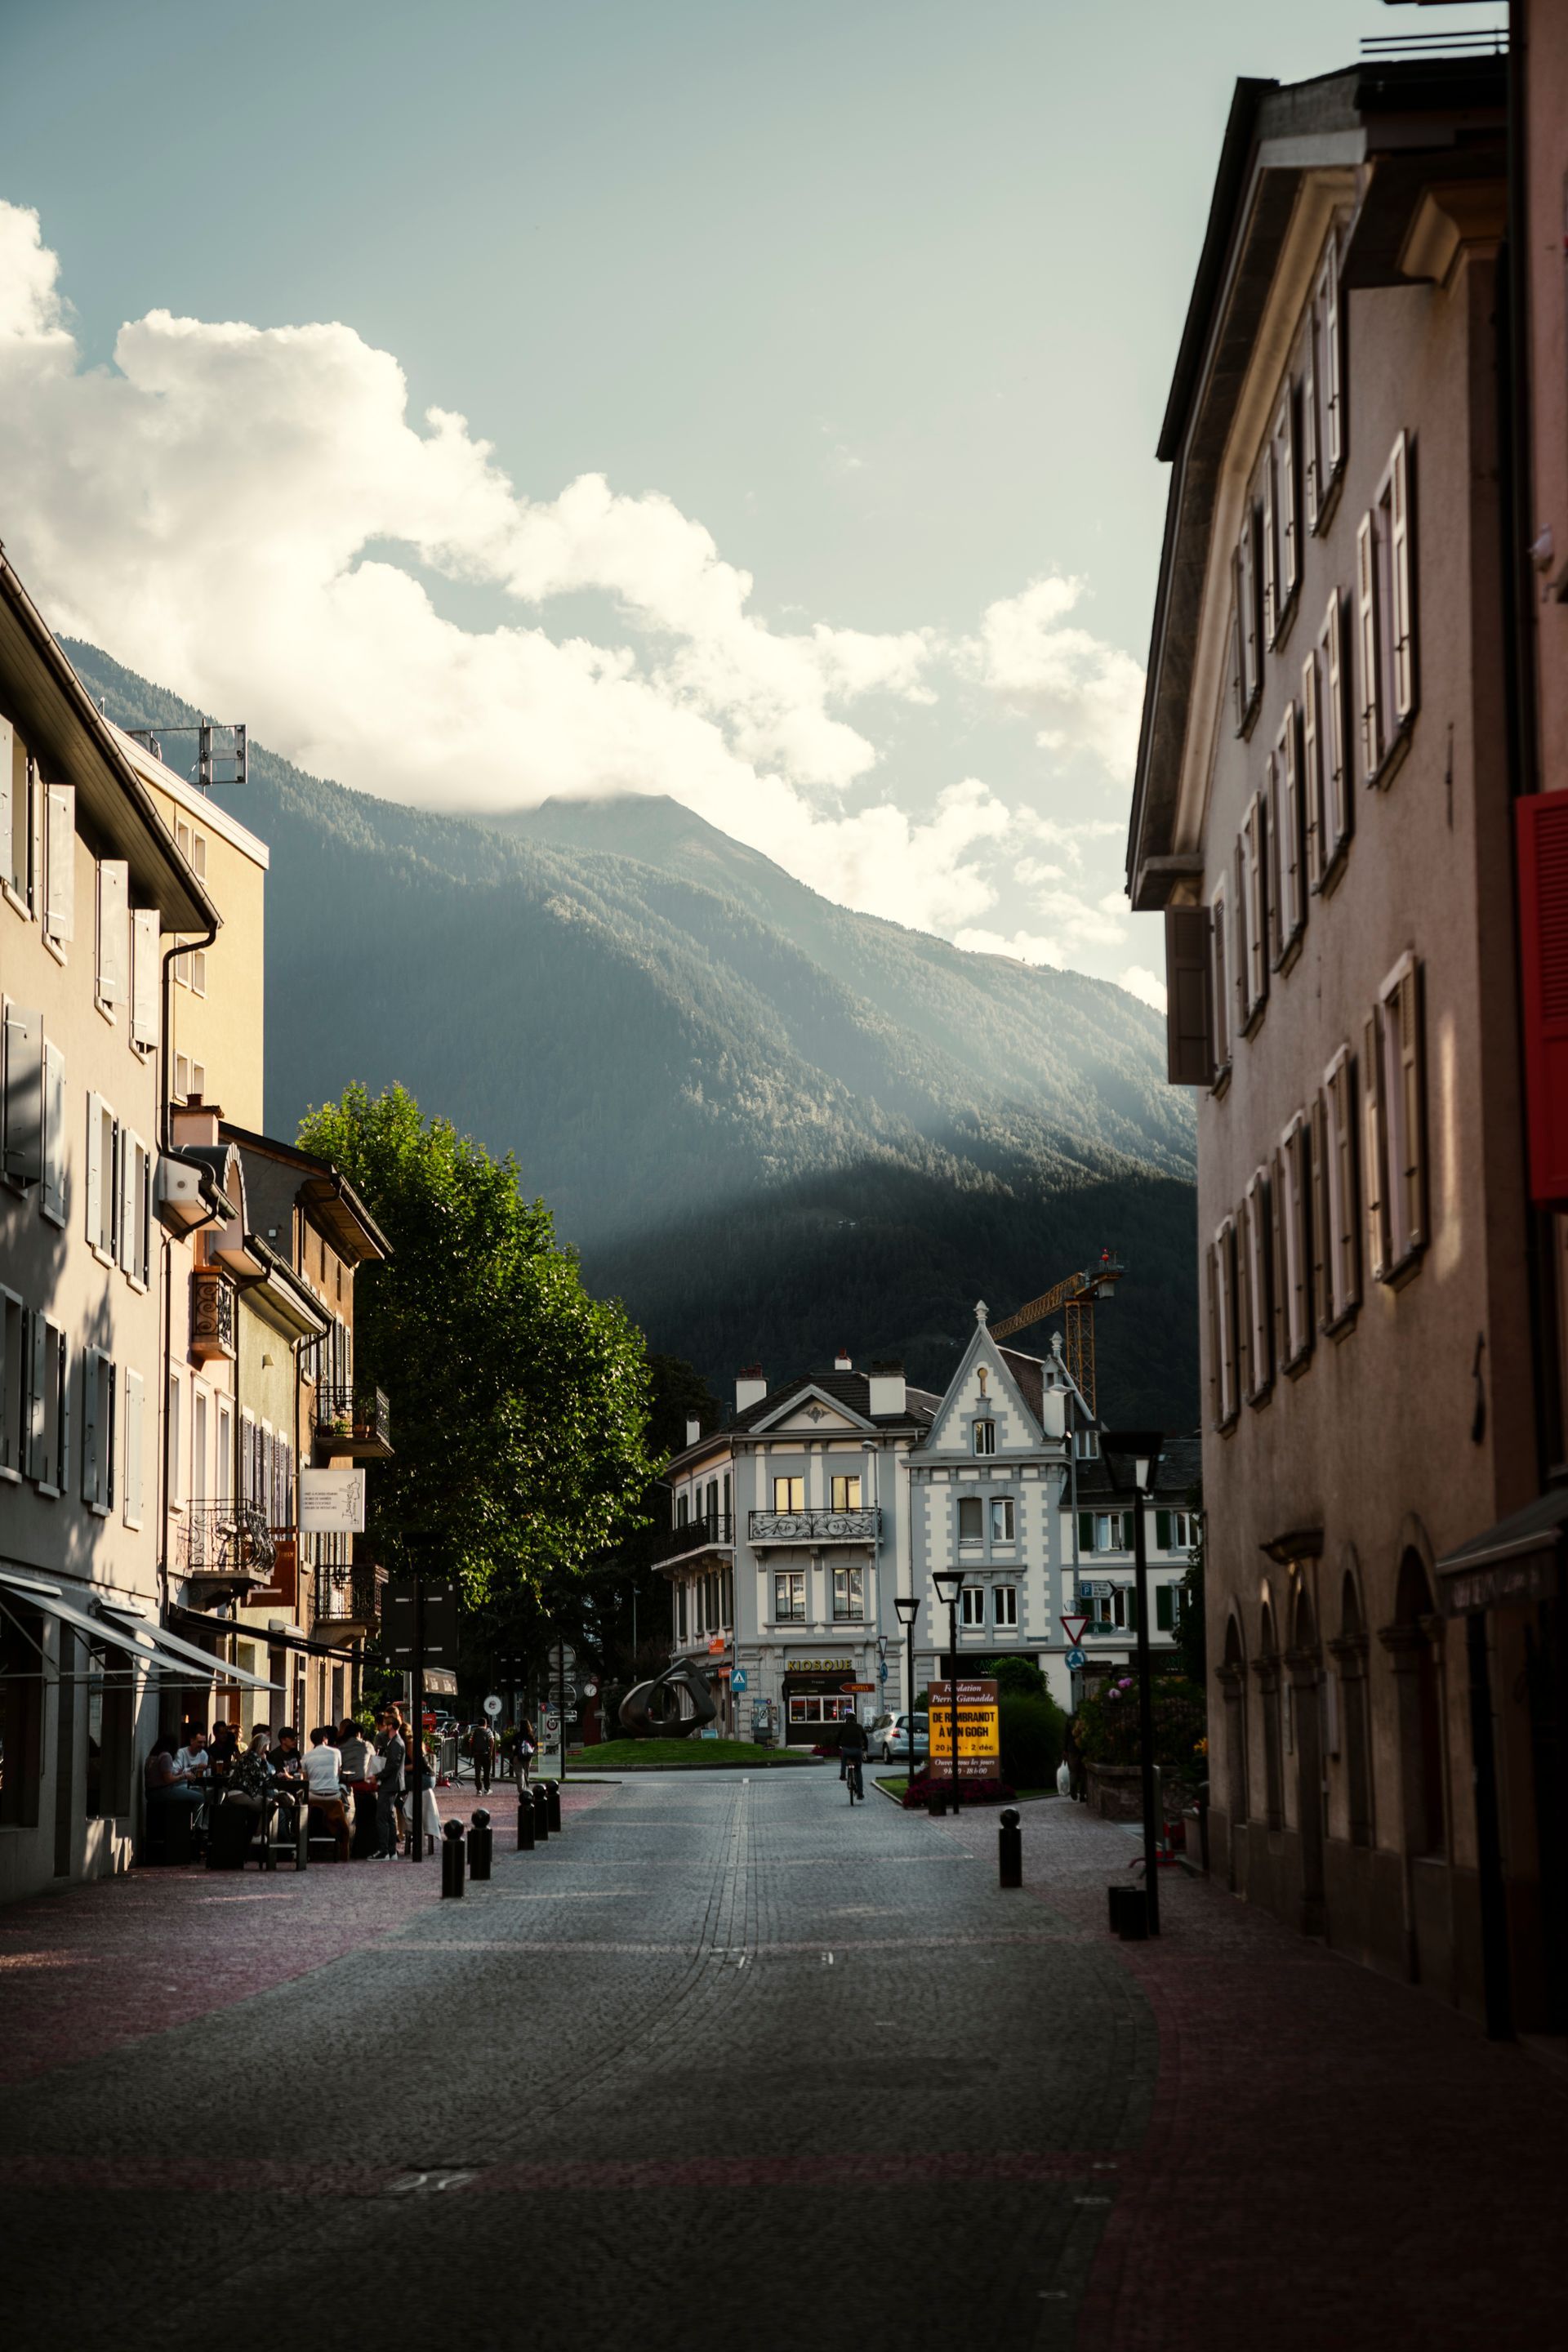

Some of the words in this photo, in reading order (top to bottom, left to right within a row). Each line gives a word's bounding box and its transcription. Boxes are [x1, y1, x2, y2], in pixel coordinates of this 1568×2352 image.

[788, 1659, 852, 1672] KIOSQUE
[944, 1684, 982, 1692] Fodation
[932, 1695, 952, 1703] Pierr
[956, 1694, 994, 1703] Gianadda
[933, 1713, 942, 1722] DE
[939, 1725, 945, 1737] À
[947, 1727, 964, 1737] VN
[965, 1726, 988, 1737] GOGH
[978, 1759, 995, 1767] jours
